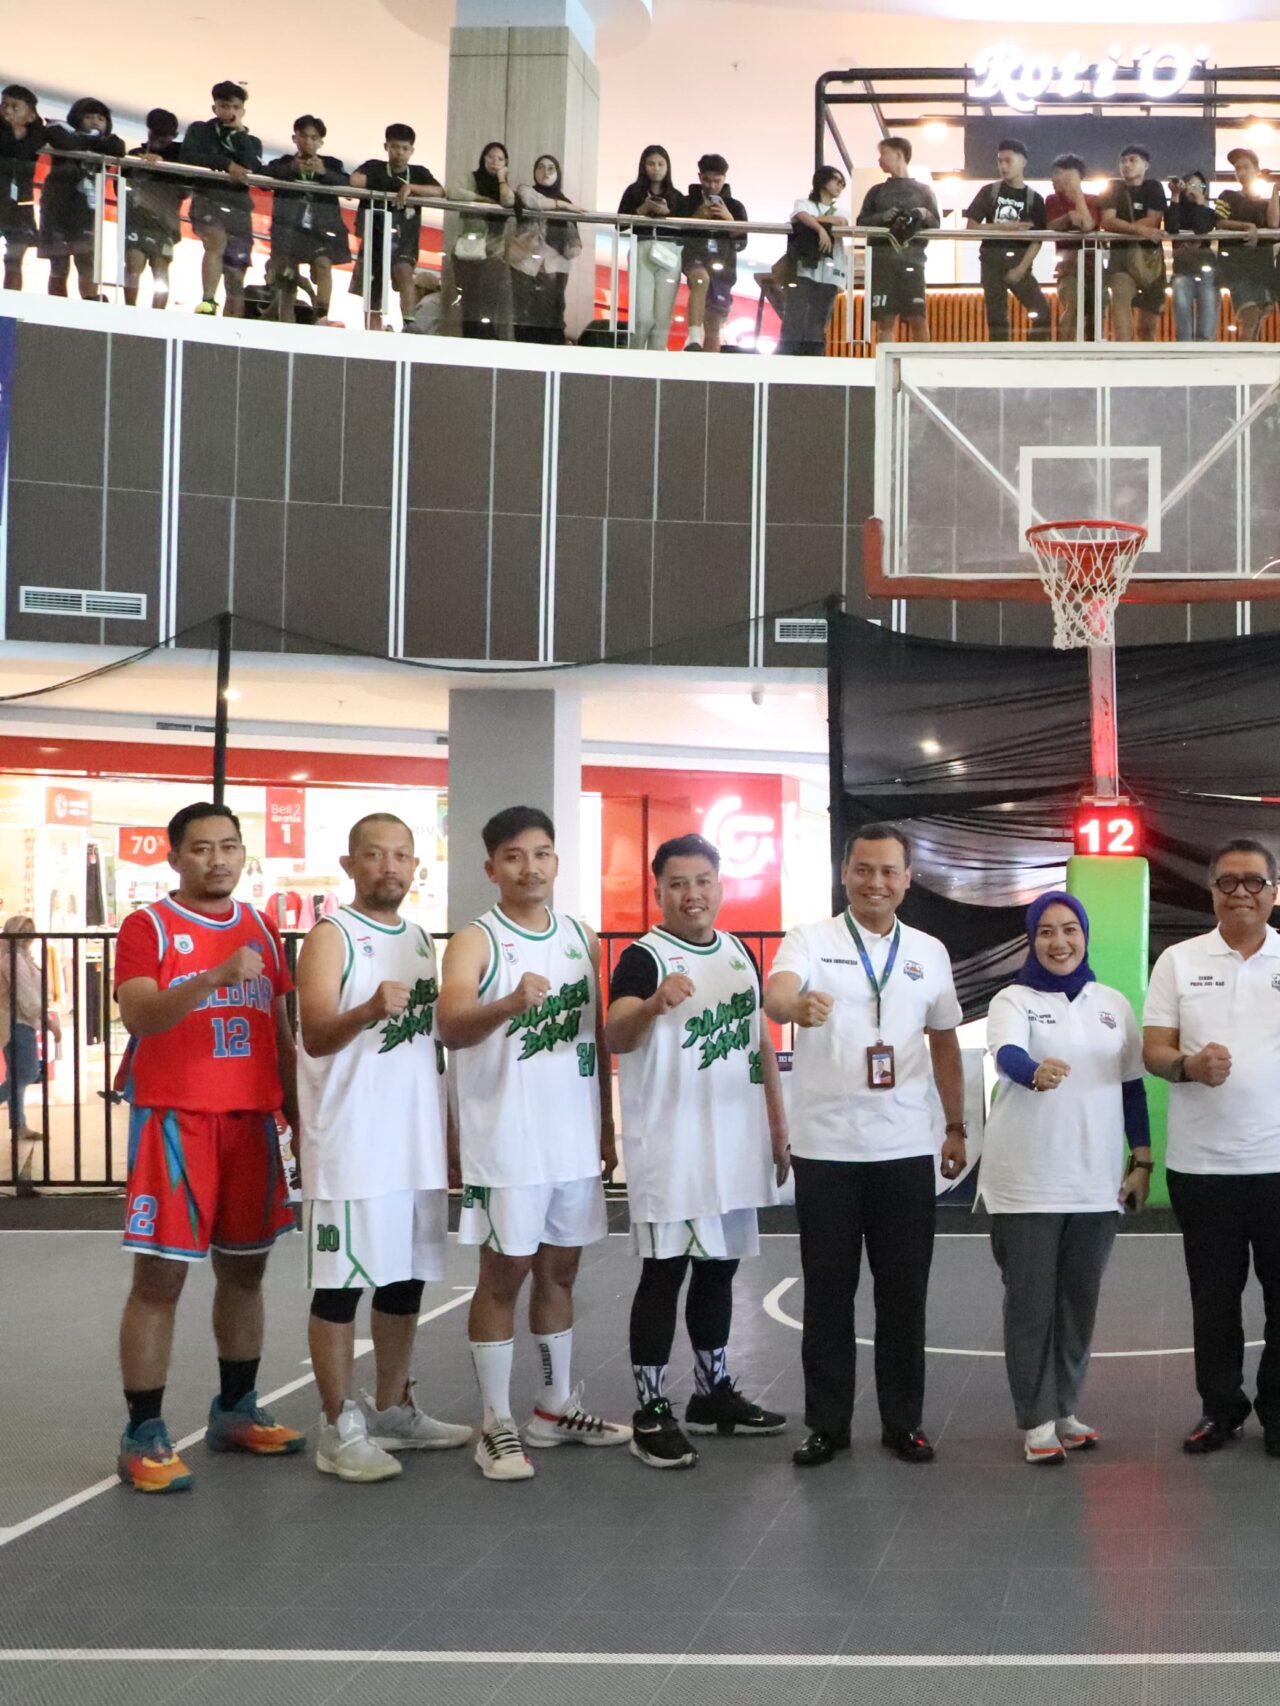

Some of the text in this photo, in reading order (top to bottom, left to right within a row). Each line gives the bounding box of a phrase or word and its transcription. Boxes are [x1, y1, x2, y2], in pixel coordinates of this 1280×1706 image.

[271, 804, 301, 818] Beli 2
[271, 814, 301, 823] Gratis
[280, 823, 291, 844] 1
[1079, 818, 1135, 853] 12
[211, 1017, 251, 1058] 12
[517, 1010, 582, 1061] BARAT
[698, 1018, 750, 1070] BARAT
[317, 1224, 340, 1252] 10
